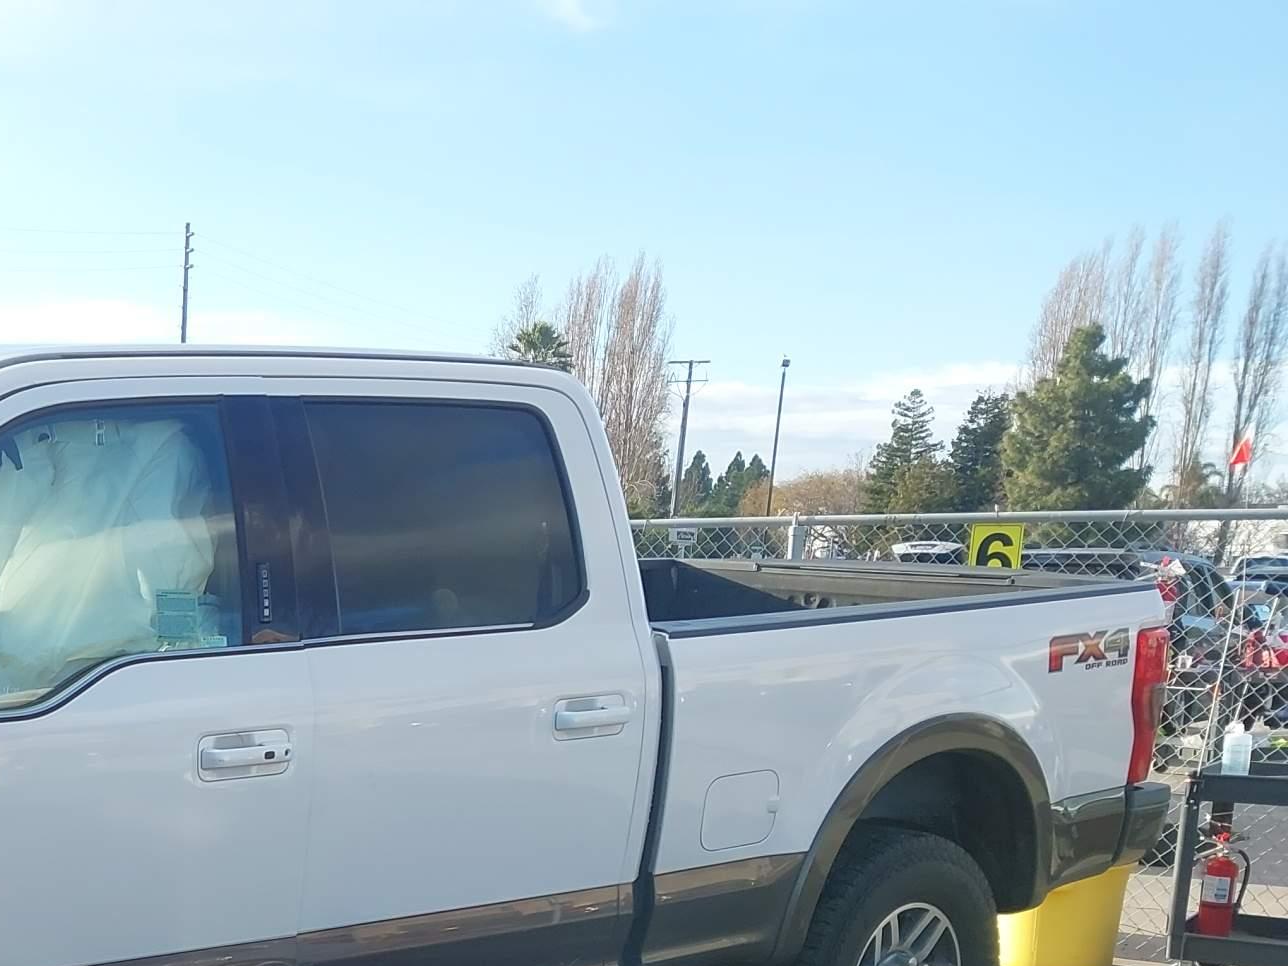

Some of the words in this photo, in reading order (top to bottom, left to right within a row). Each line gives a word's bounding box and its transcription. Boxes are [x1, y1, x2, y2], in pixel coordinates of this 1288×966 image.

[976, 532, 1014, 568] 6
[1048, 627, 1130, 674] FX4
[1084, 660, 1103, 671] OFF
[1105, 658, 1129, 668] ROAD
